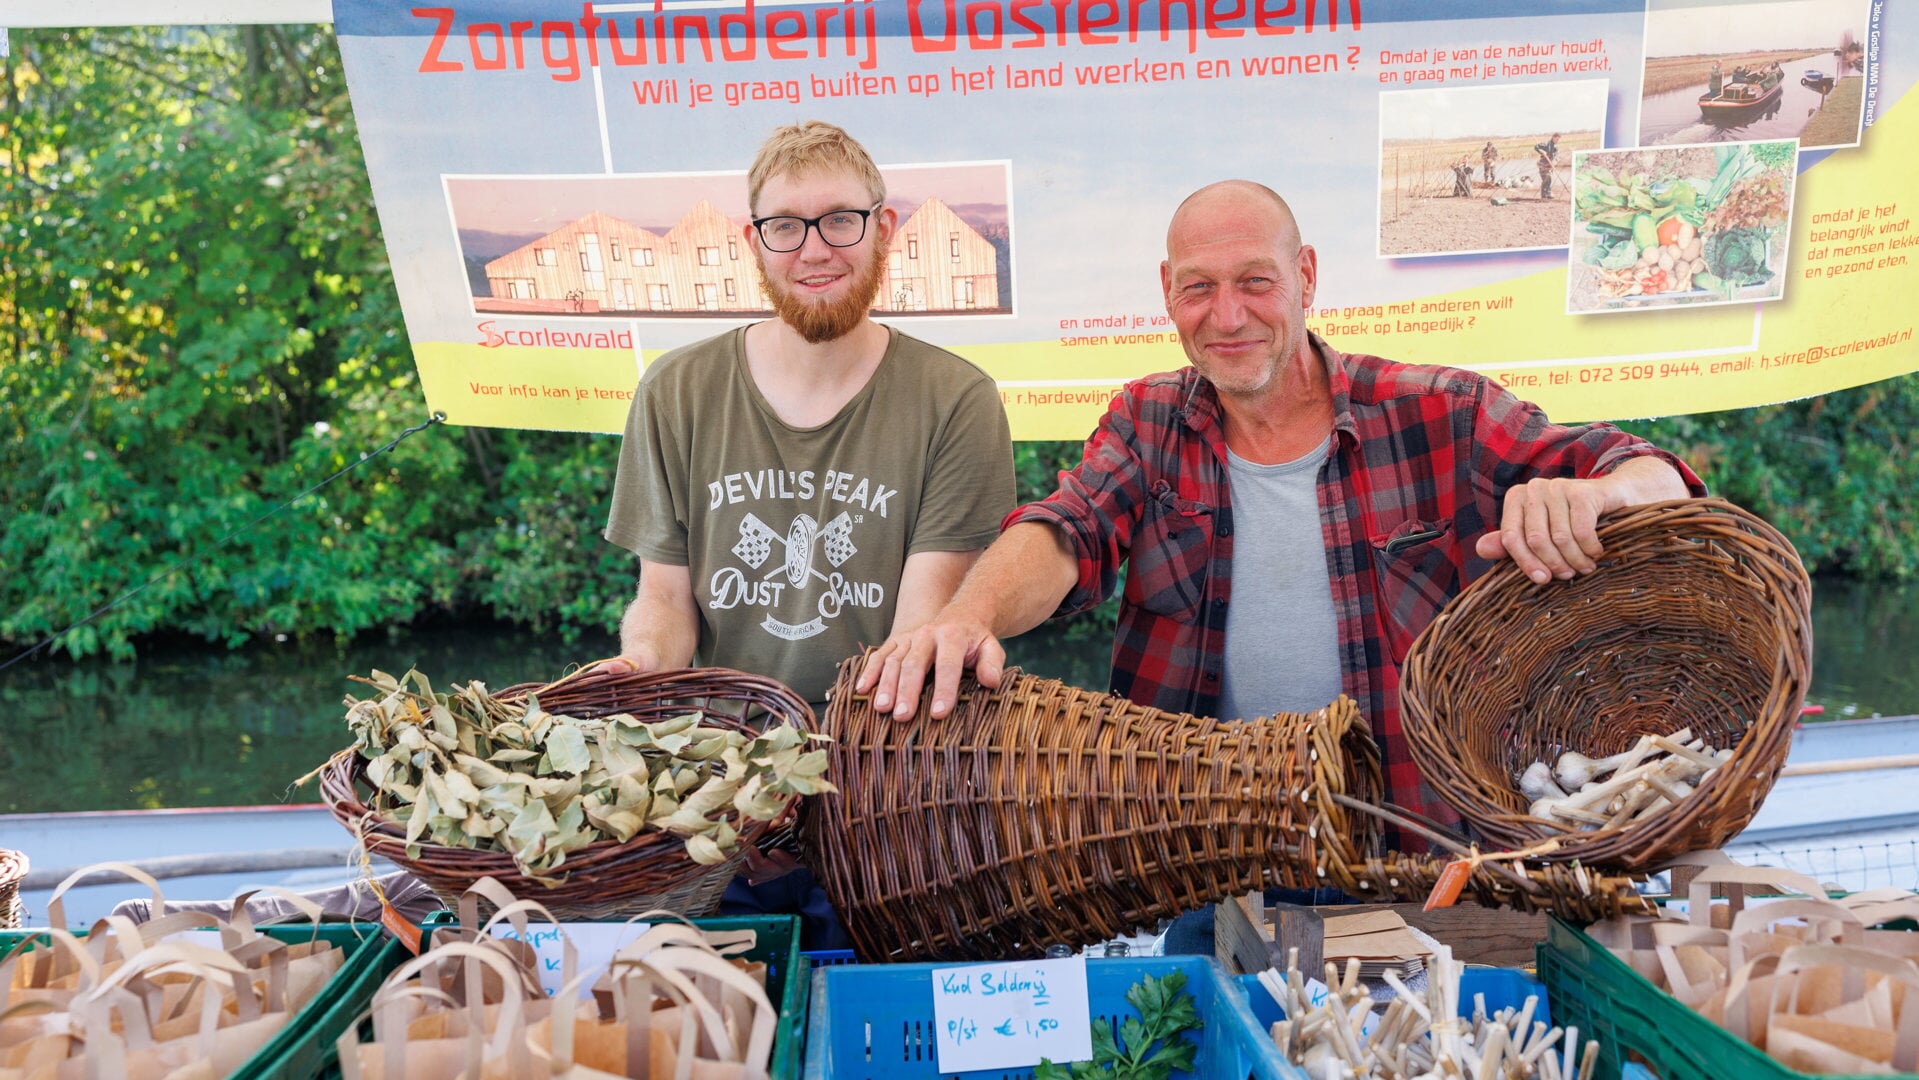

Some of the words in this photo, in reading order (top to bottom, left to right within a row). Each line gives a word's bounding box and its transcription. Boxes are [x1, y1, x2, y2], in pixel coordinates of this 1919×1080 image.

[410, 0, 878, 82] Zorgtuinderij
[1379, 49, 1428, 65] Omdat
[1432, 48, 1447, 65] je
[1452, 48, 1478, 61] van
[1483, 45, 1502, 59] de
[1507, 43, 1556, 58] natuur
[1561, 38, 1607, 57] houdt,
[632, 79, 678, 105] Wil
[688, 78, 713, 108] je
[724, 80, 801, 106] graag
[810, 71, 897, 98] buiten
[907, 74, 939, 97] op
[951, 64, 995, 96] het
[1006, 61, 1063, 88] land
[1074, 57, 1185, 86] werken
[1196, 59, 1231, 79] en
[1241, 53, 1339, 77] wonen
[1346, 46, 1361, 71] ?
[1379, 70, 1398, 83] en
[1403, 68, 1445, 85] graag
[1450, 63, 1478, 79] met
[1482, 63, 1496, 80] je
[1501, 60, 1558, 79] handen
[1870, 62, 1879, 85] NMA
[1868, 86, 1878, 98] De
[1812, 208, 1854, 224] omdat
[1856, 207, 1870, 222] je
[1875, 202, 1897, 219] het
[1810, 223, 1875, 243] belangrijk
[1879, 218, 1910, 235] vindt
[1807, 246, 1829, 261] dat
[1832, 242, 1885, 258] mensen
[1805, 267, 1822, 279] en
[1826, 258, 1875, 278] gezond
[1320, 308, 1338, 319] en
[1343, 305, 1384, 319] graag
[1388, 301, 1415, 315] met
[1420, 299, 1481, 313] anderen
[1486, 296, 1513, 310] wilt
[1060, 318, 1078, 329] en
[1083, 314, 1127, 328] omdat
[1131, 314, 1145, 330] je
[1326, 321, 1368, 336] Broek
[1374, 322, 1392, 336] op
[1396, 317, 1465, 334] Langedijk
[477, 320, 634, 350] Scorlewald
[1060, 336, 1108, 347] samen
[1113, 333, 1164, 345] wonen
[1499, 373, 1542, 388] Sirre,
[1549, 370, 1573, 385] tel:
[1579, 368, 1614, 383] 072
[1619, 365, 1654, 380] 509
[1660, 362, 1703, 377] 9444,
[1710, 356, 1755, 374] email:
[1760, 327, 1913, 371] h.sirre@scorlewald.nl
[469, 382, 503, 396] Voor
[508, 384, 538, 398] info
[543, 385, 571, 399] kan
[575, 386, 589, 401] je
[594, 387, 636, 400] terec
[708, 468, 815, 511] DEVIL'S
[824, 469, 898, 518] PEAK
[768, 621, 792, 637] SOUTH
